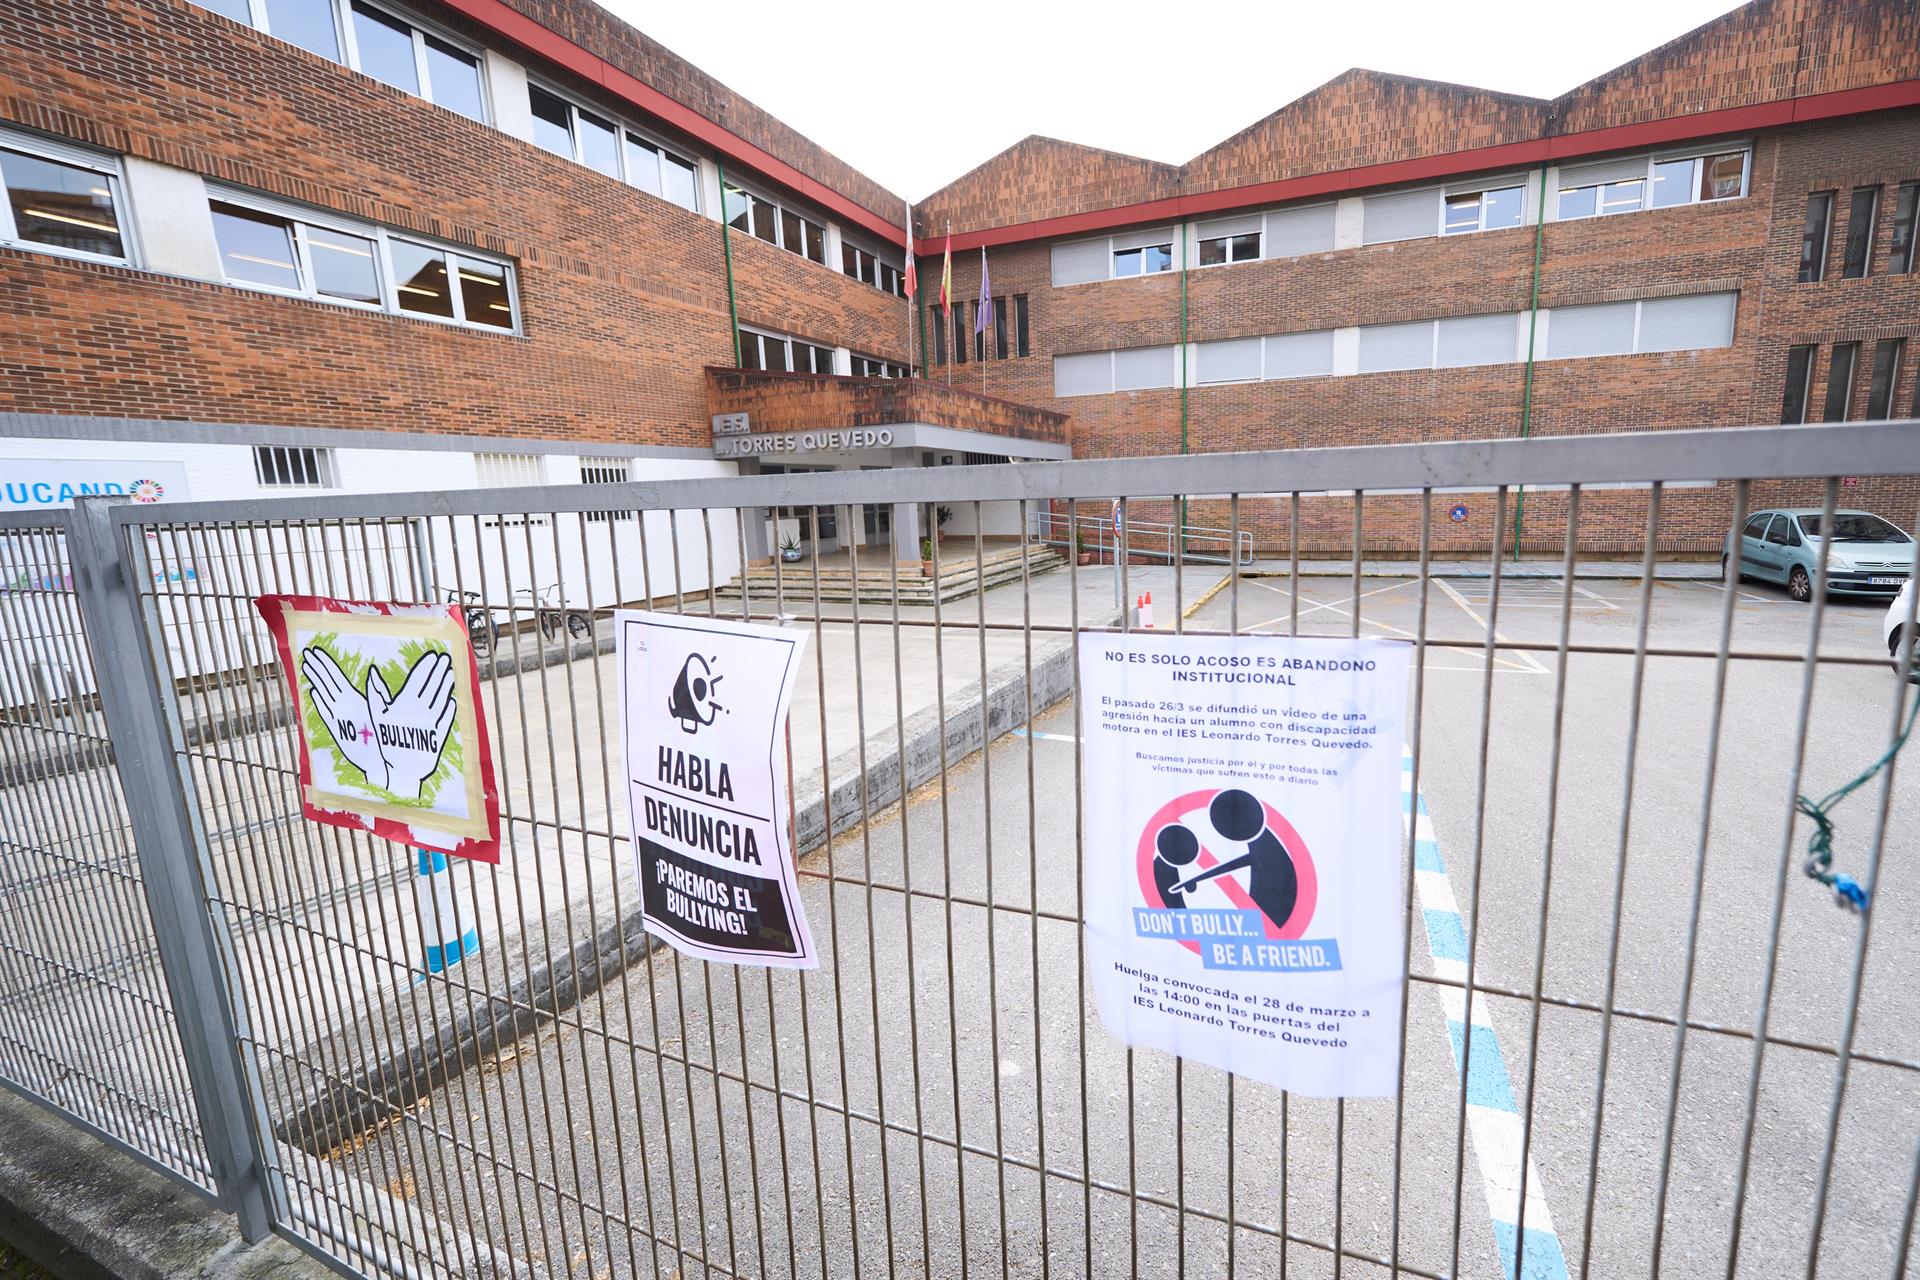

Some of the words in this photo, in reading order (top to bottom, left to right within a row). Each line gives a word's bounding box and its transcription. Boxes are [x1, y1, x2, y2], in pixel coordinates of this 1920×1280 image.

[803, 429, 893, 450] QUEVEDO
[0, 482, 123, 504] UCAND
[1105, 651, 1124, 662] NO
[1129, 653, 1146, 663] ES
[1152, 654, 1190, 665] SOLO
[1196, 656, 1250, 667] ACOSO
[1257, 657, 1276, 667] ES
[1282, 658, 1376, 671] ABANDONO
[1173, 671, 1296, 686] INSTITUCIONAL
[1102, 696, 1111, 705] El
[1114, 698, 1155, 709] pasado
[1160, 702, 1184, 711] 26/3
[1207, 704, 1257, 714] difundió
[1262, 708, 1277, 716] un
[1282, 707, 1316, 720] vídeo
[1322, 711, 1337, 720] de
[1102, 710, 1149, 722] agresión
[1154, 714, 1186, 724] hacia
[1210, 718, 1255, 727] alumno
[1288, 722, 1376, 735] discapacidad
[337, 719, 356, 742] NO
[379, 724, 438, 753] BULLYING
[1102, 723, 1140, 734] motora
[1162, 728, 1172, 736] el
[1177, 729, 1196, 738] IES
[1202, 730, 1260, 741] Leonardo
[1265, 734, 1306, 746] Torres
[1312, 739, 1373, 749] Quevedo.
[658, 745, 734, 802] HABLA
[1136, 752, 1184, 763] Buscamos
[1188, 756, 1225, 765] justicia
[1269, 763, 1285, 771] por
[1289, 765, 1318, 774] todas
[1322, 768, 1338, 776] las
[1152, 764, 1193, 774] víctimas
[1196, 768, 1214, 776] que
[1218, 770, 1250, 778] sufren
[1253, 772, 1275, 781] esto
[1288, 776, 1318, 785] diario
[644, 795, 762, 866] DENUNCIA
[655, 858, 729, 907] ¡PAREMOS
[734, 886, 758, 913] EL
[666, 888, 748, 936] BULLYING!
[1138, 912, 1187, 934] DON'T
[1192, 914, 1258, 936] BULLY...
[1213, 943, 1237, 965] BE
[1242, 945, 1253, 966] A
[1257, 944, 1330, 967] FRIEND.
[1115, 962, 1158, 982] Huelga
[1163, 976, 1238, 1000] convocada
[1244, 994, 1257, 1005] el
[1263, 997, 1280, 1009] 28
[1286, 1002, 1304, 1013] de
[1310, 1007, 1356, 1017] marzo
[1362, 1009, 1370, 1017] a
[1139, 983, 1158, 996] las
[1163, 990, 1200, 1006] 14:00
[1205, 1002, 1222, 1012] en
[1227, 1004, 1248, 1017] las
[1253, 1013, 1311, 1032] puertas
[1318, 1021, 1340, 1032] del
[1133, 995, 1154, 1009] IES
[1159, 1003, 1224, 1026] Leonardo
[1229, 1019, 1276, 1039] Torres
[1281, 1031, 1347, 1048] Quevedo
